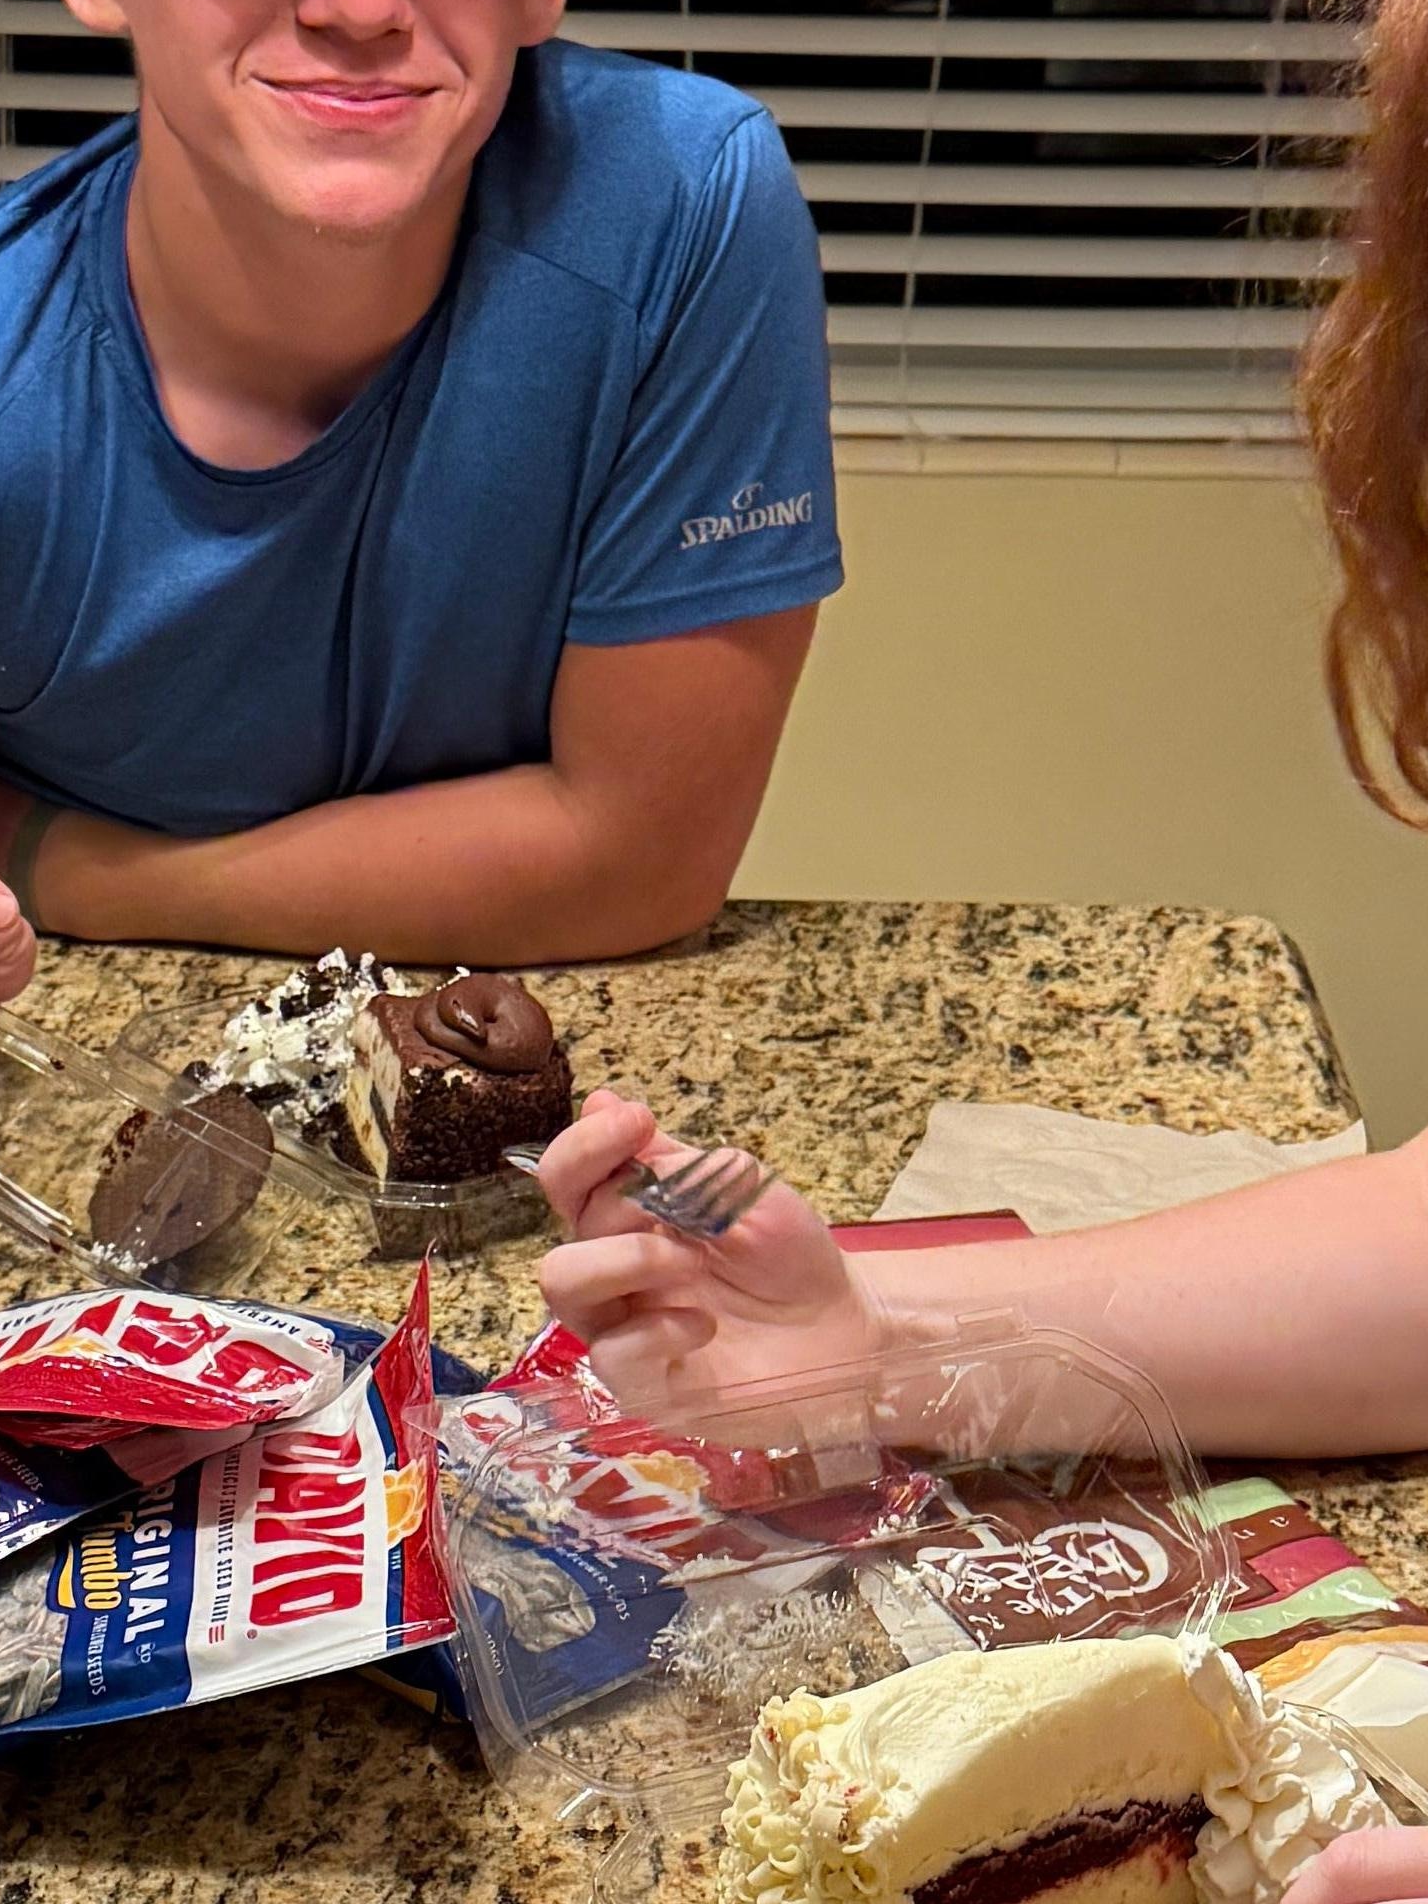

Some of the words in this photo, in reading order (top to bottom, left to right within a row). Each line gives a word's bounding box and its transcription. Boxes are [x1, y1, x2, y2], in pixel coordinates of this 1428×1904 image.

[681, 492, 813, 550] SPALDING
[76, 1510, 135, 1610] Jumbo
[123, 1479, 175, 1643] RIGINAL
[250, 1430, 367, 1627] DAVID
[216, 1558, 234, 1590] SEED
[86, 1654, 107, 1696] SEEDS
